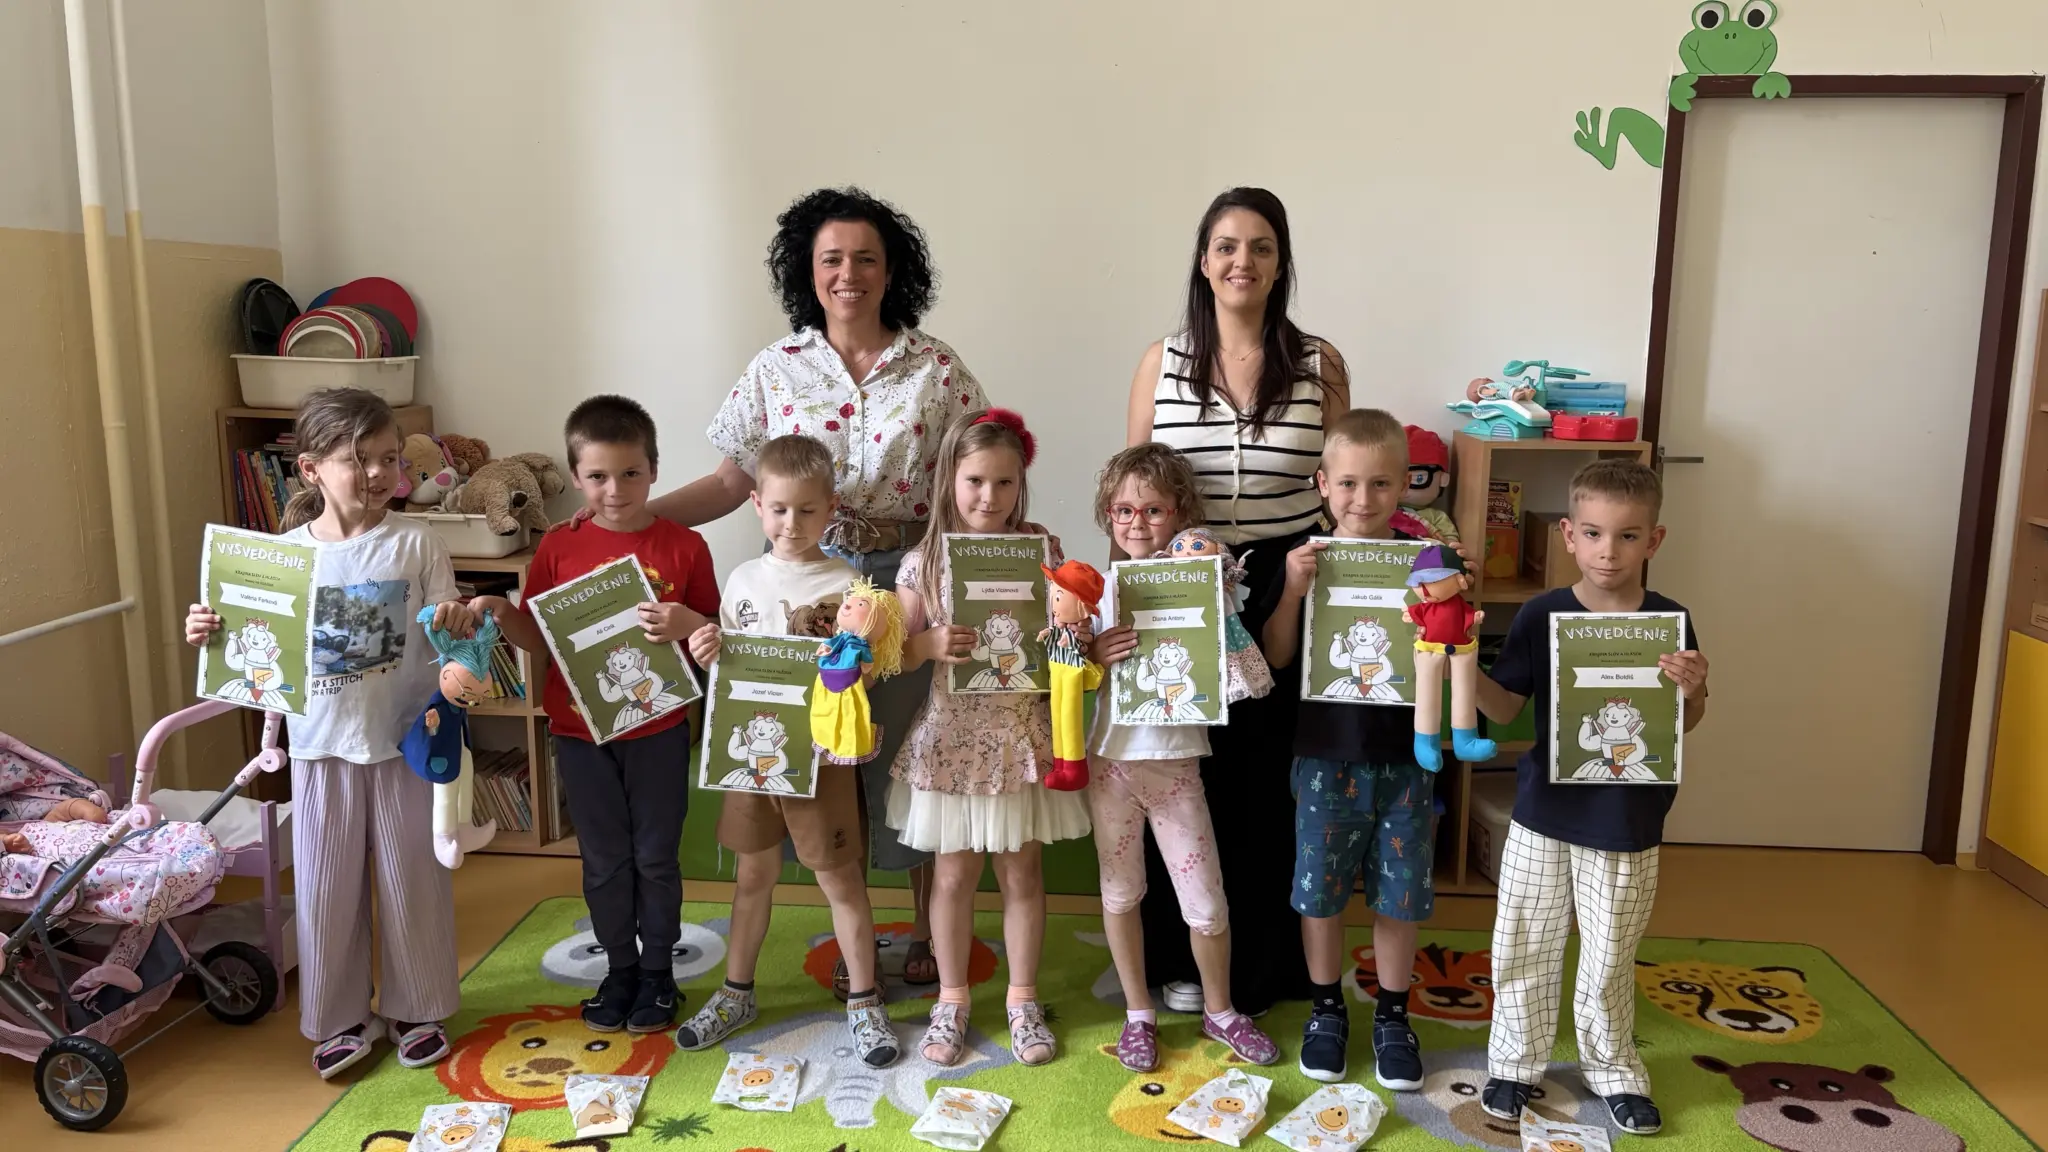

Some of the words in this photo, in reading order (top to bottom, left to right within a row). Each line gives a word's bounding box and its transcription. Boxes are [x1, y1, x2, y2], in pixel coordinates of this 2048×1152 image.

[216, 542, 308, 572] VYSVEDČENIE
[954, 545, 1038, 560] VYSVEDČENIE
[1322, 550, 1417, 567] VYSVEDČENIE
[1124, 569, 1209, 586] VYSVEDČENIE
[545, 573, 632, 615] VYSVEDČENIE
[1564, 625, 1670, 642] VYSVEDČENIE
[727, 644, 817, 664] VYSVEDČENIE
[322, 680, 327, 688] &
[329, 673, 363, 687] STITCH
[326, 687, 342, 696] TRIP
